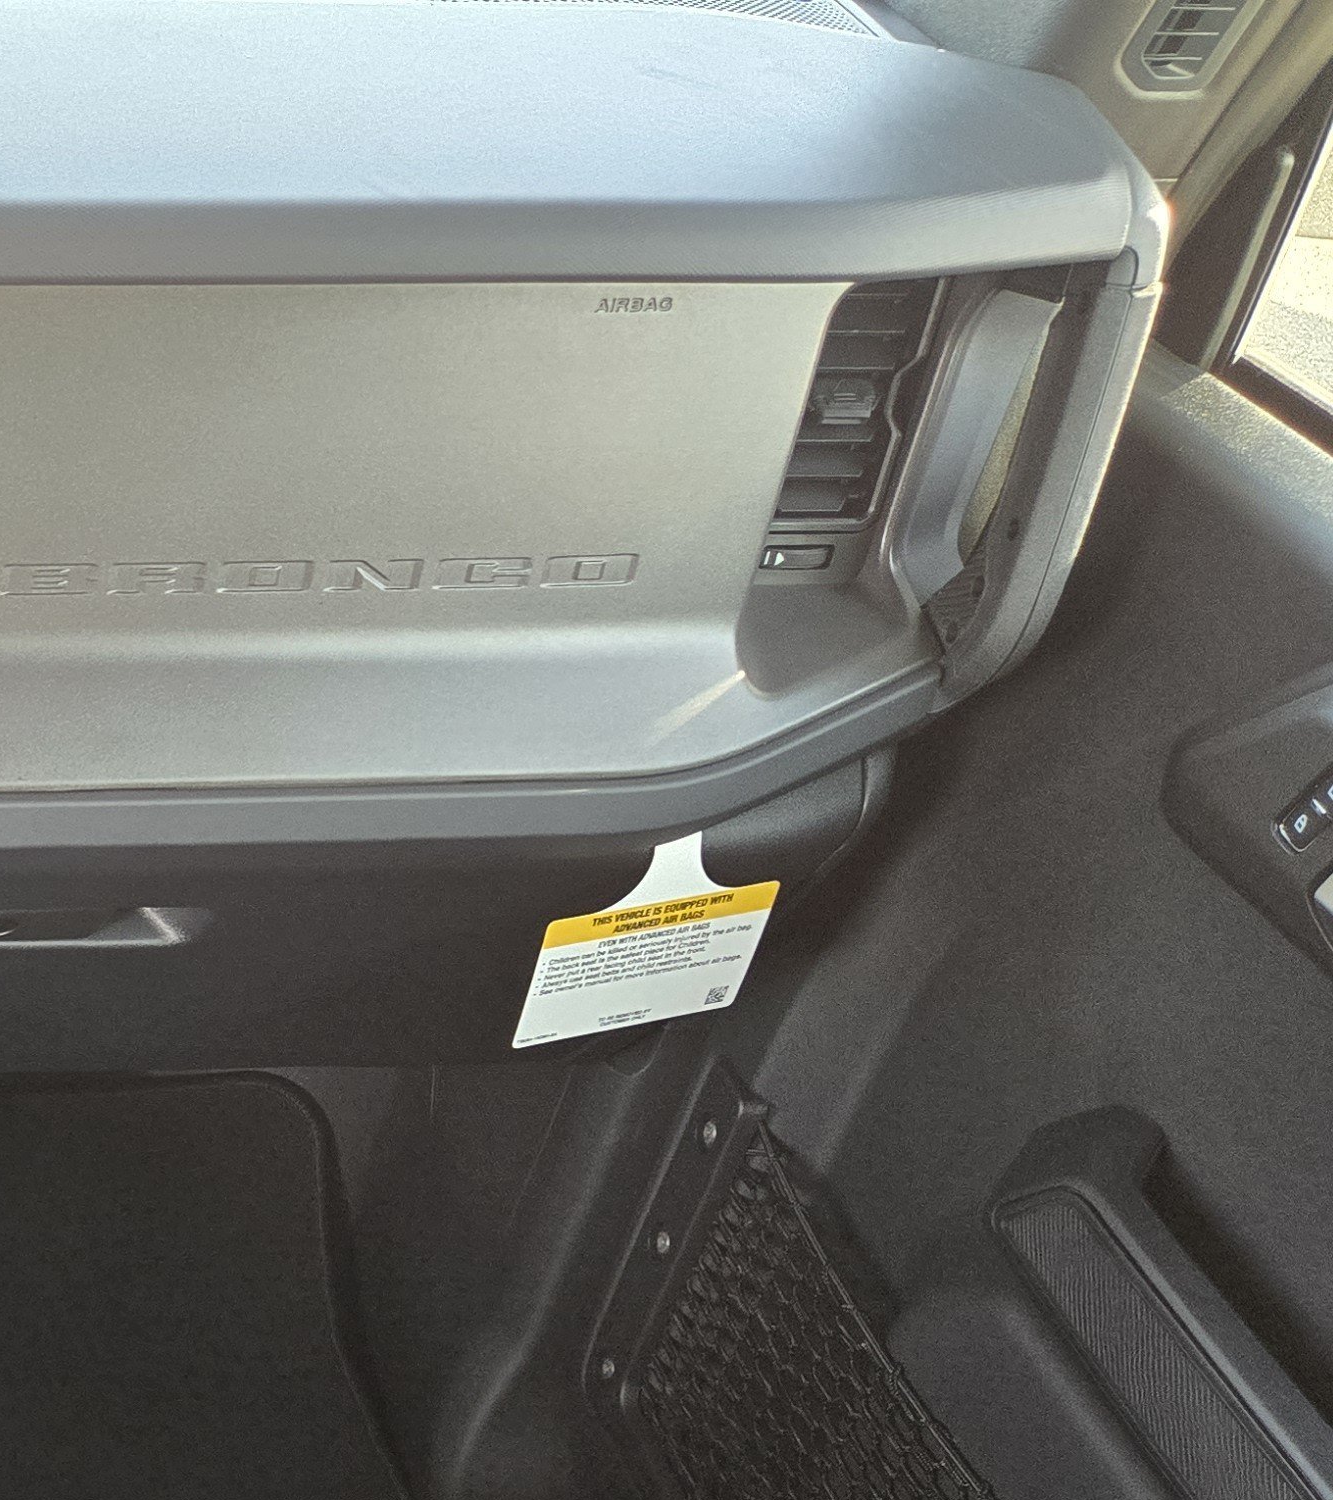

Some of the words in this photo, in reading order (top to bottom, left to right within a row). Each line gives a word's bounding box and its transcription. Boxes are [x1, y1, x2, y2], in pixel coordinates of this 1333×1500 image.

[594, 296, 674, 314] AIRBAG
[0, 552, 640, 596] BRONCO
[593, 916, 613, 926] THIS
[615, 908, 652, 922] VEHICLE
[653, 906, 662, 916] IS
[663, 899, 708, 914] EQUIPPED
[710, 893, 734, 905] WITH
[613, 918, 661, 933] ADVANCED
[662, 915, 678, 925] AIR
[680, 910, 705, 922] BAGS
[639, 928, 676, 940] ADVANCED
[677, 925, 690, 933] AIR
[691, 922, 711, 930] BAGS
[549, 955, 581, 965] Children
[639, 938, 673, 948] seriously
[674, 932, 701, 943] injured
[701, 931, 711, 939] by
